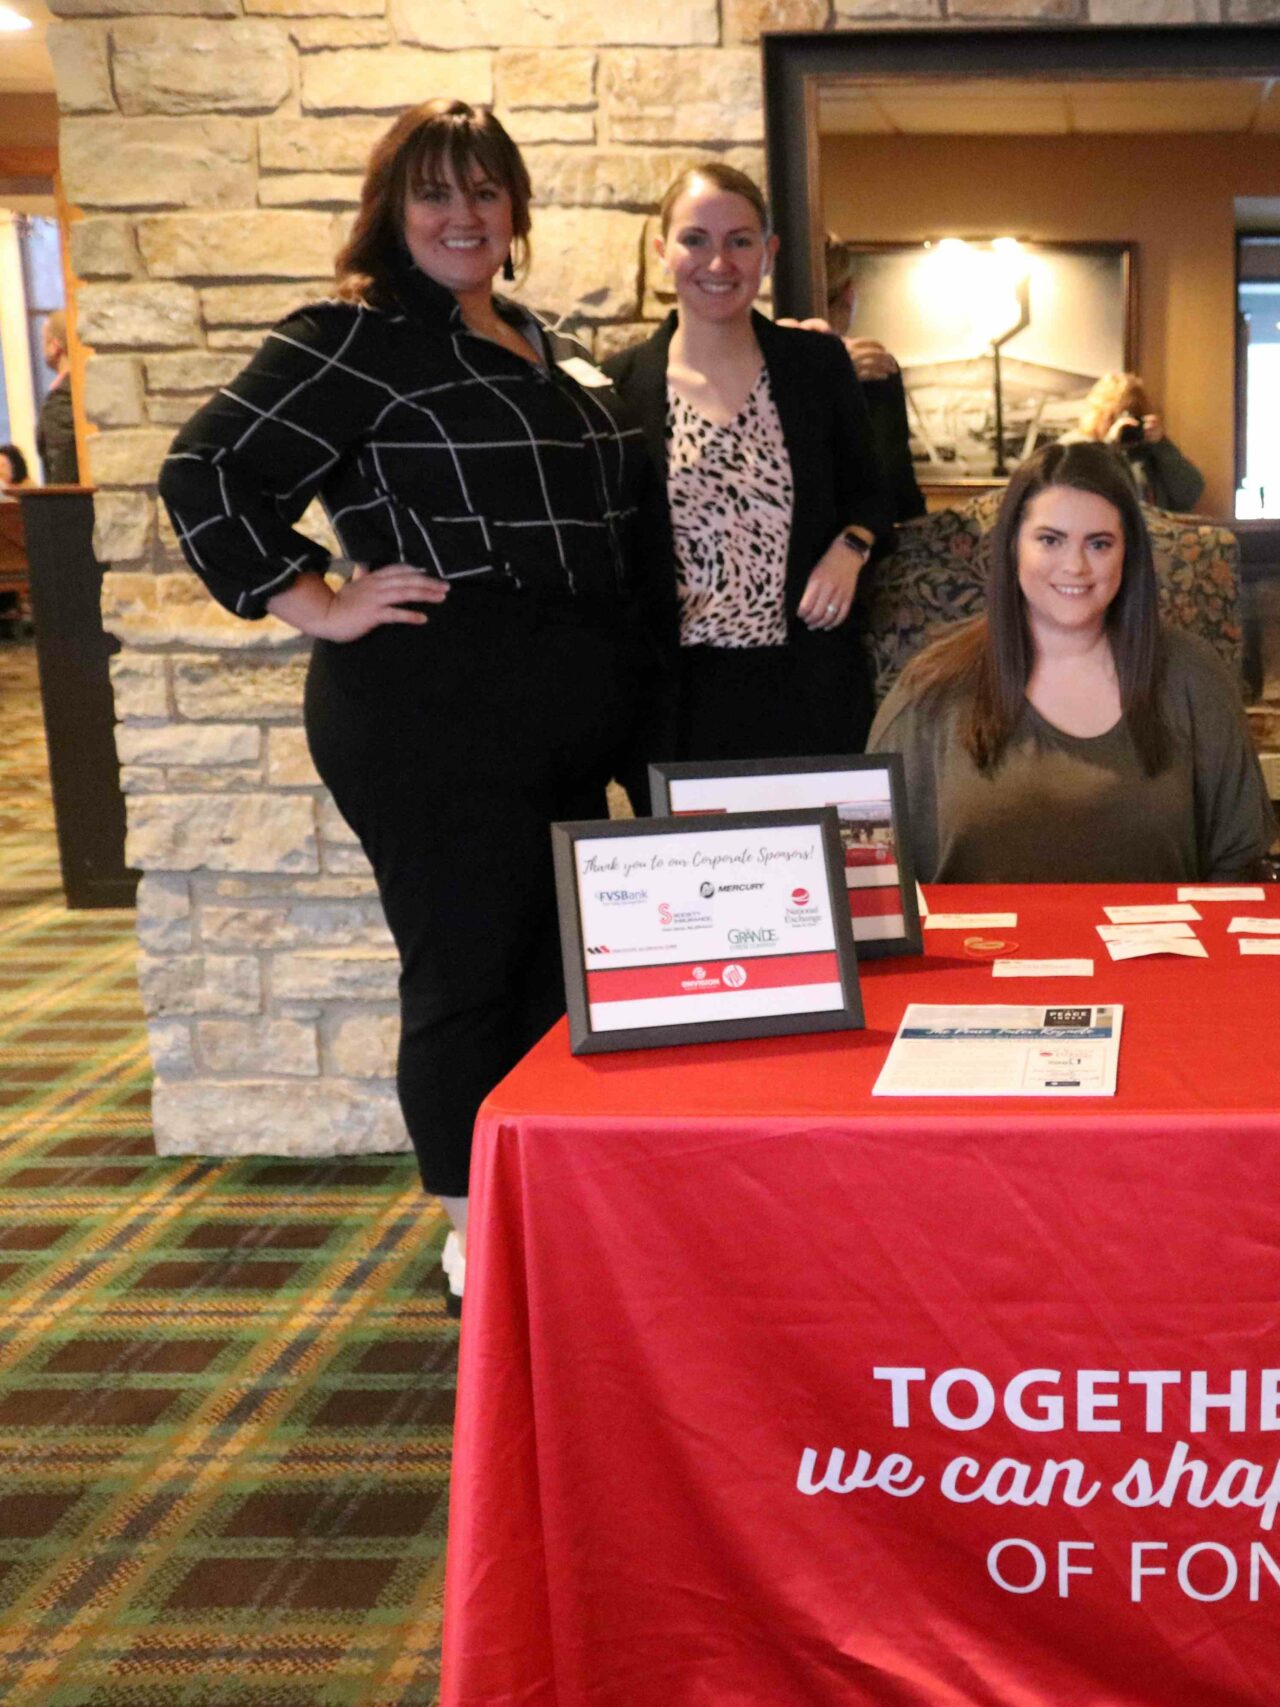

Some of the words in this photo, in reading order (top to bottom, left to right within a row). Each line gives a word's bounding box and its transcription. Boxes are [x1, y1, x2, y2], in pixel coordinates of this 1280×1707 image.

[583, 855, 618, 875] Thank
[624, 860, 646, 878] you
[651, 854, 664, 870] to
[668, 858, 687, 867] our
[692, 848, 752, 870] Corporate
[757, 845, 815, 866] Sponsors!
[718, 882, 765, 893] MERCURY
[784, 914, 822, 924] Exchange
[796, 1447, 925, 1498] we
[940, 1455, 1102, 1508] can
[986, 1537, 1095, 1599] OF
